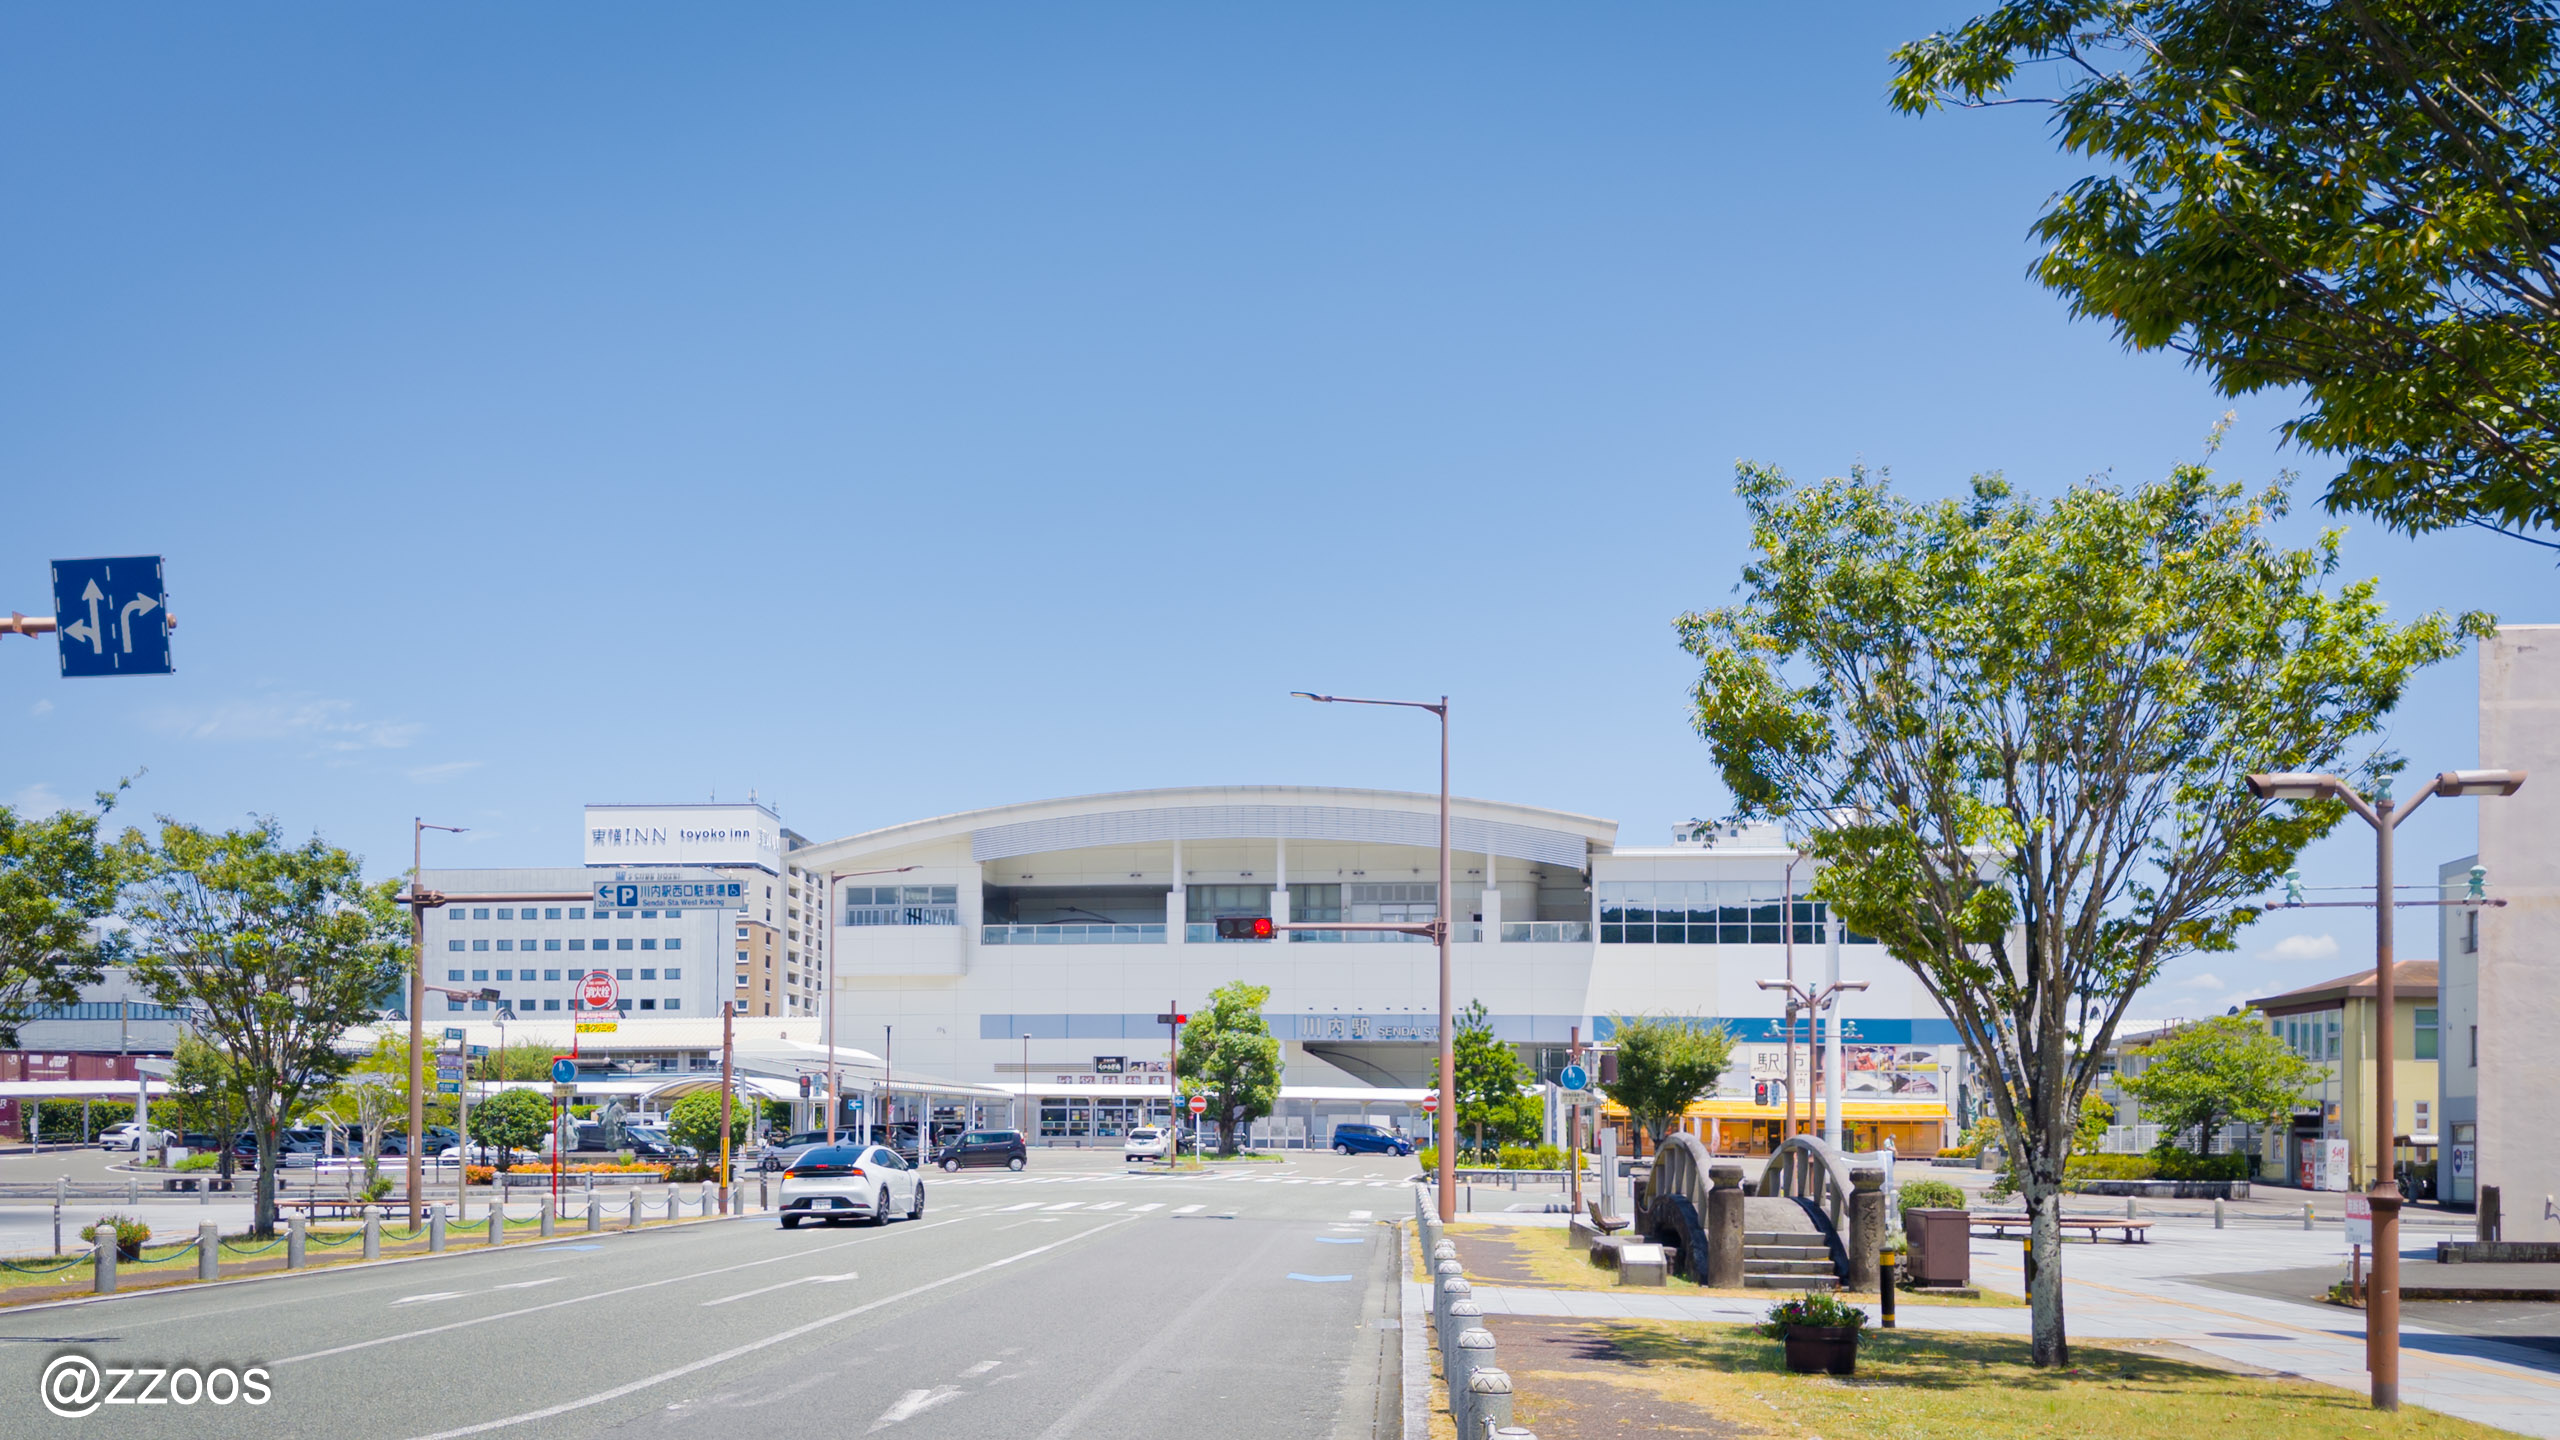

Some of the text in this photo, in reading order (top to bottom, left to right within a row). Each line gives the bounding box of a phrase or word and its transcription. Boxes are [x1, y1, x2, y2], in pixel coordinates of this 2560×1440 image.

[592, 828, 666, 846] 東横INN
[680, 828, 750, 841] toyoko inn
[641, 885, 725, 897] 川内駅西口駐車場
[642, 899, 666, 907] Sendai
[699, 898, 725, 907] Parking
[585, 985, 610, 998] 消火栓
[1302, 1017, 1371, 1036] 川内駅
[1377, 1026, 1420, 1037] SENDAI
